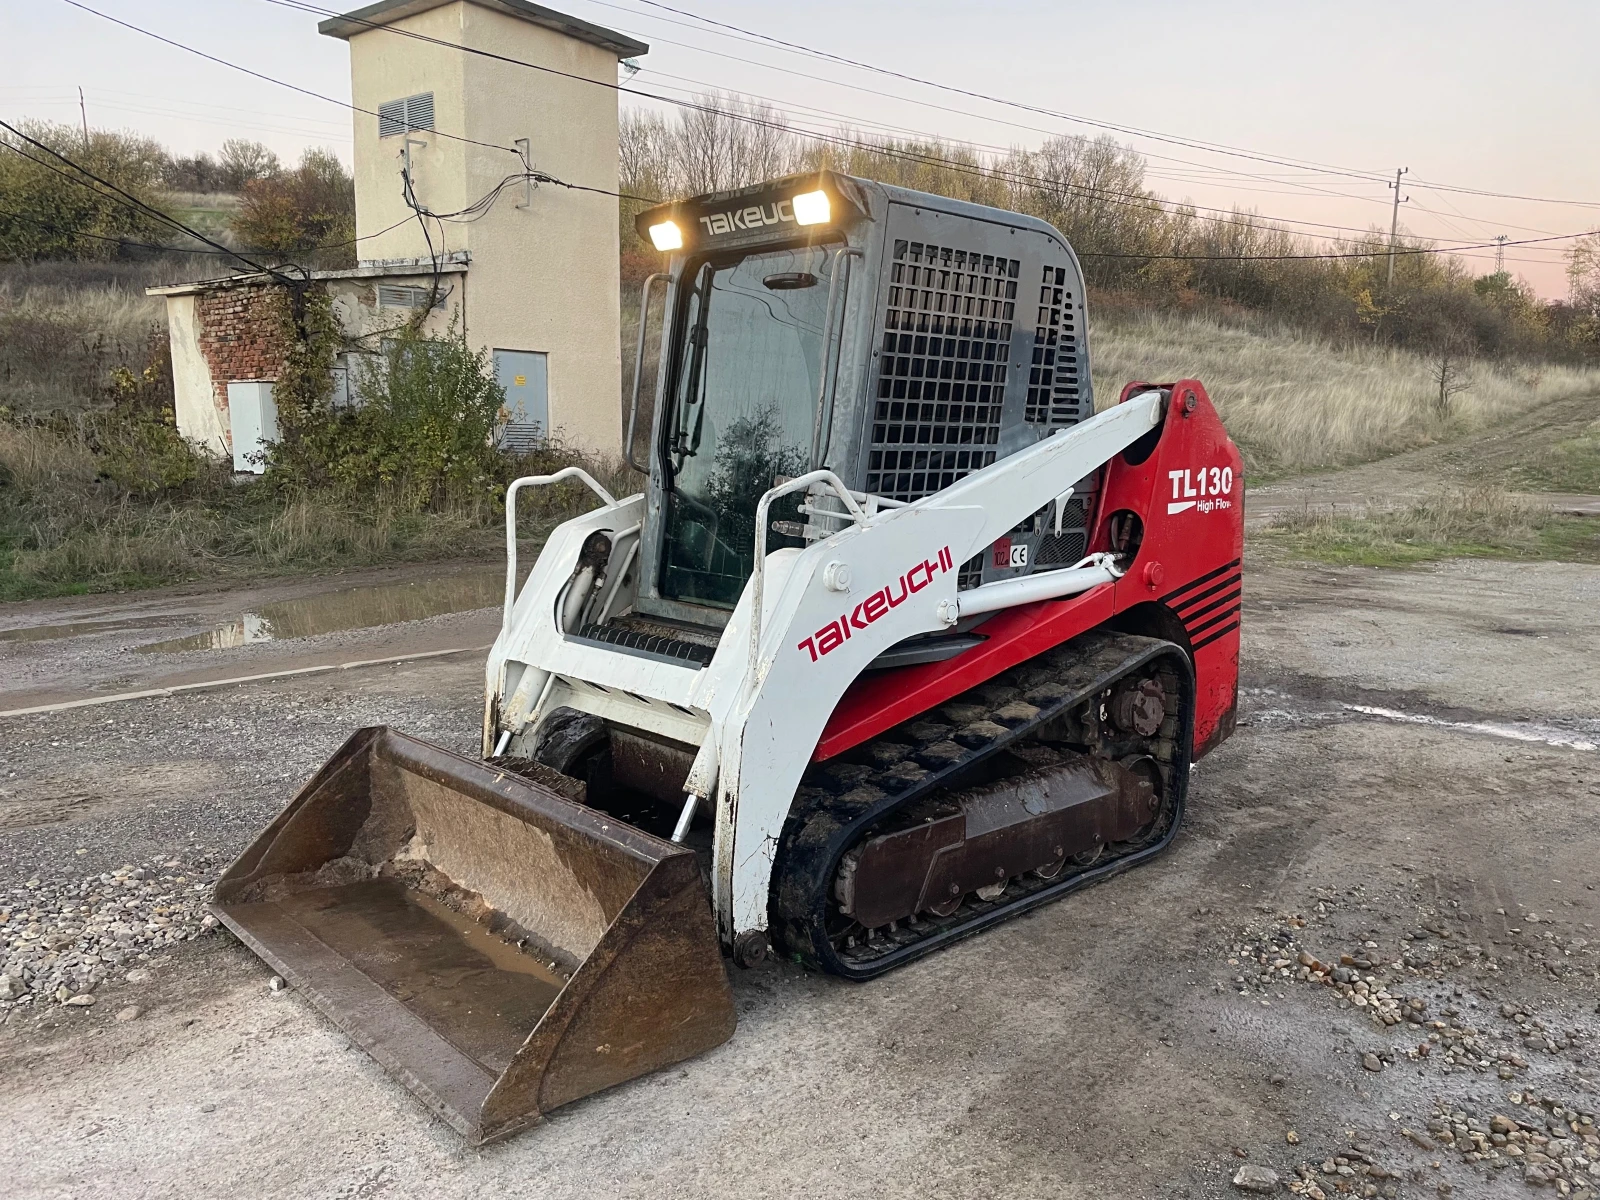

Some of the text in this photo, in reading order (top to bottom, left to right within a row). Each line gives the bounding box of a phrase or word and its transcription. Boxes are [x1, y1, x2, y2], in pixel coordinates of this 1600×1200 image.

[700, 200, 795, 236] TAKEUC
[1168, 466, 1233, 499] TL130
[1197, 499, 1214, 514] High
[1011, 547, 1026, 564] CE
